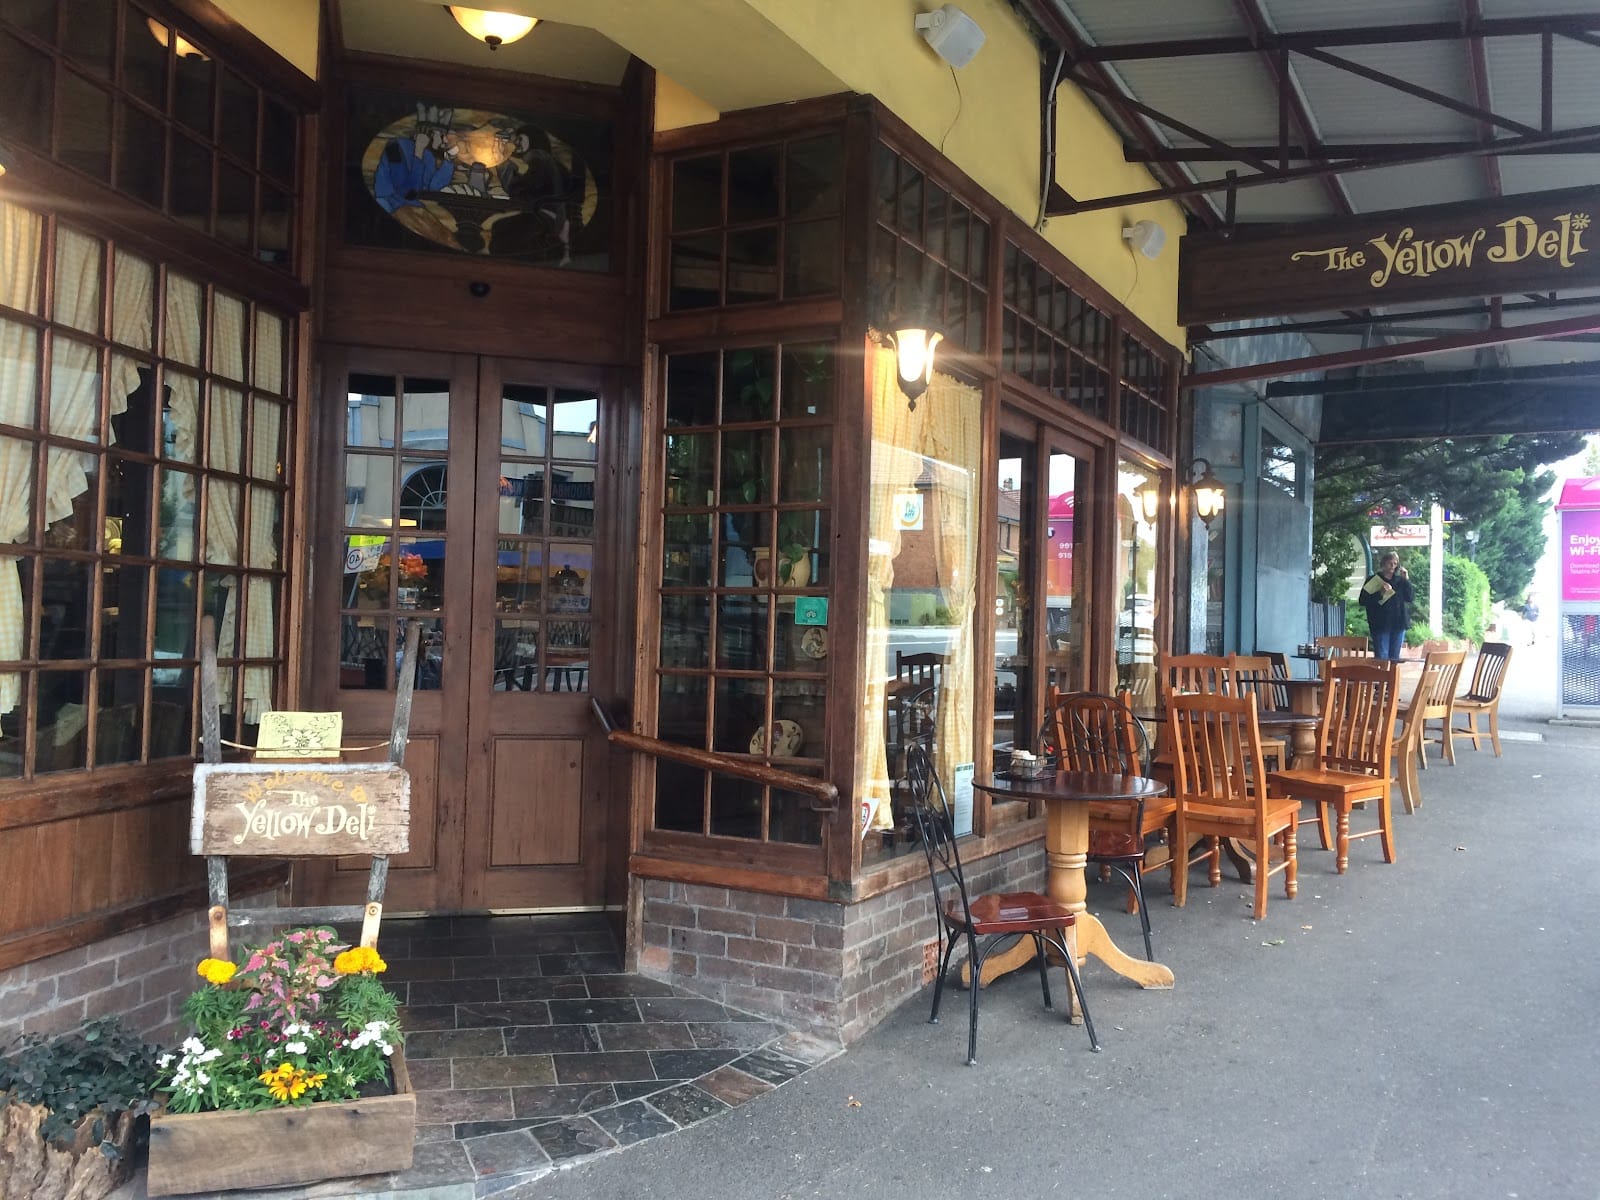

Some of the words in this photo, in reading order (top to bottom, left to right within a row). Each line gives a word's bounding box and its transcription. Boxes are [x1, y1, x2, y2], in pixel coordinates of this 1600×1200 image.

[1291, 246, 1366, 272] The
[1367, 227, 1486, 288] Yellow
[1487, 212, 1591, 268] Deli
[241, 770, 345, 802] Welcome
[266, 789, 319, 807] The
[234, 799, 320, 845] Yellow
[315, 803, 377, 840] Deli
